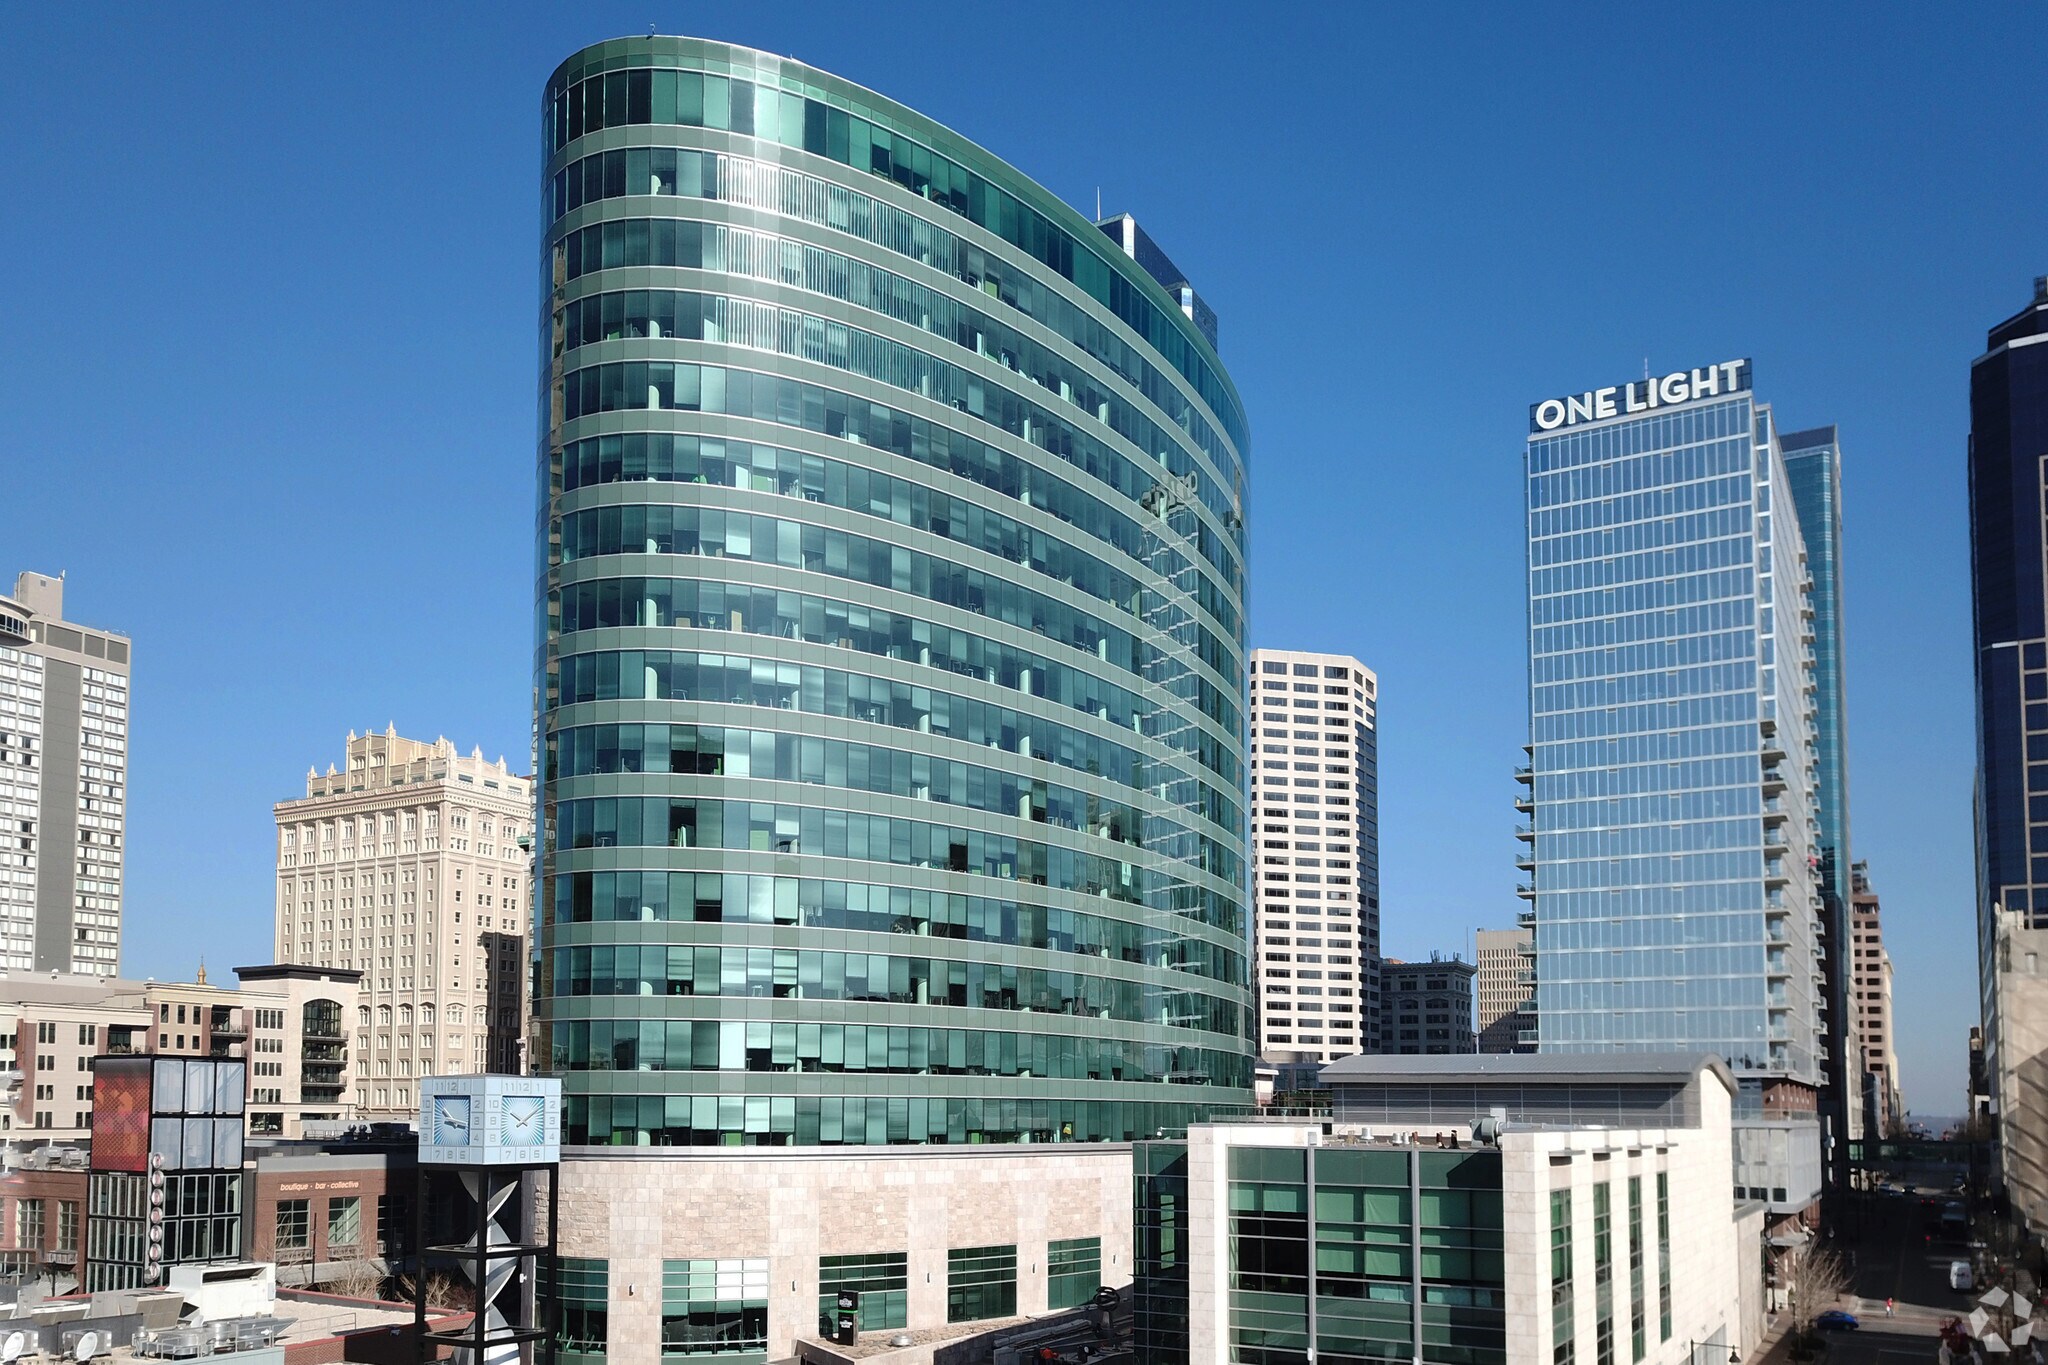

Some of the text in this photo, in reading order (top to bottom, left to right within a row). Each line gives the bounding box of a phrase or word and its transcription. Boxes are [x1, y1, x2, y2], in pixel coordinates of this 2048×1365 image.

[1536, 359, 1745, 430] ONE LIGHT
[435, 1082, 444, 1091] 11
[447, 1082, 457, 1091] 12
[505, 1083, 514, 1091] 11
[519, 1083, 529, 1091] 12
[422, 1100, 431, 1108] 10
[474, 1100, 480, 1108] 2
[489, 1100, 499, 1108] 10
[549, 1101, 556, 1109] 2
[549, 1117, 555, 1125] 3
[473, 1133, 479, 1142] 4
[549, 1133, 555, 1141] 4
[434, 1151, 441, 1159] 7
[505, 1151, 511, 1159] 7
[280, 1181, 359, 1191] boutique bar collective
